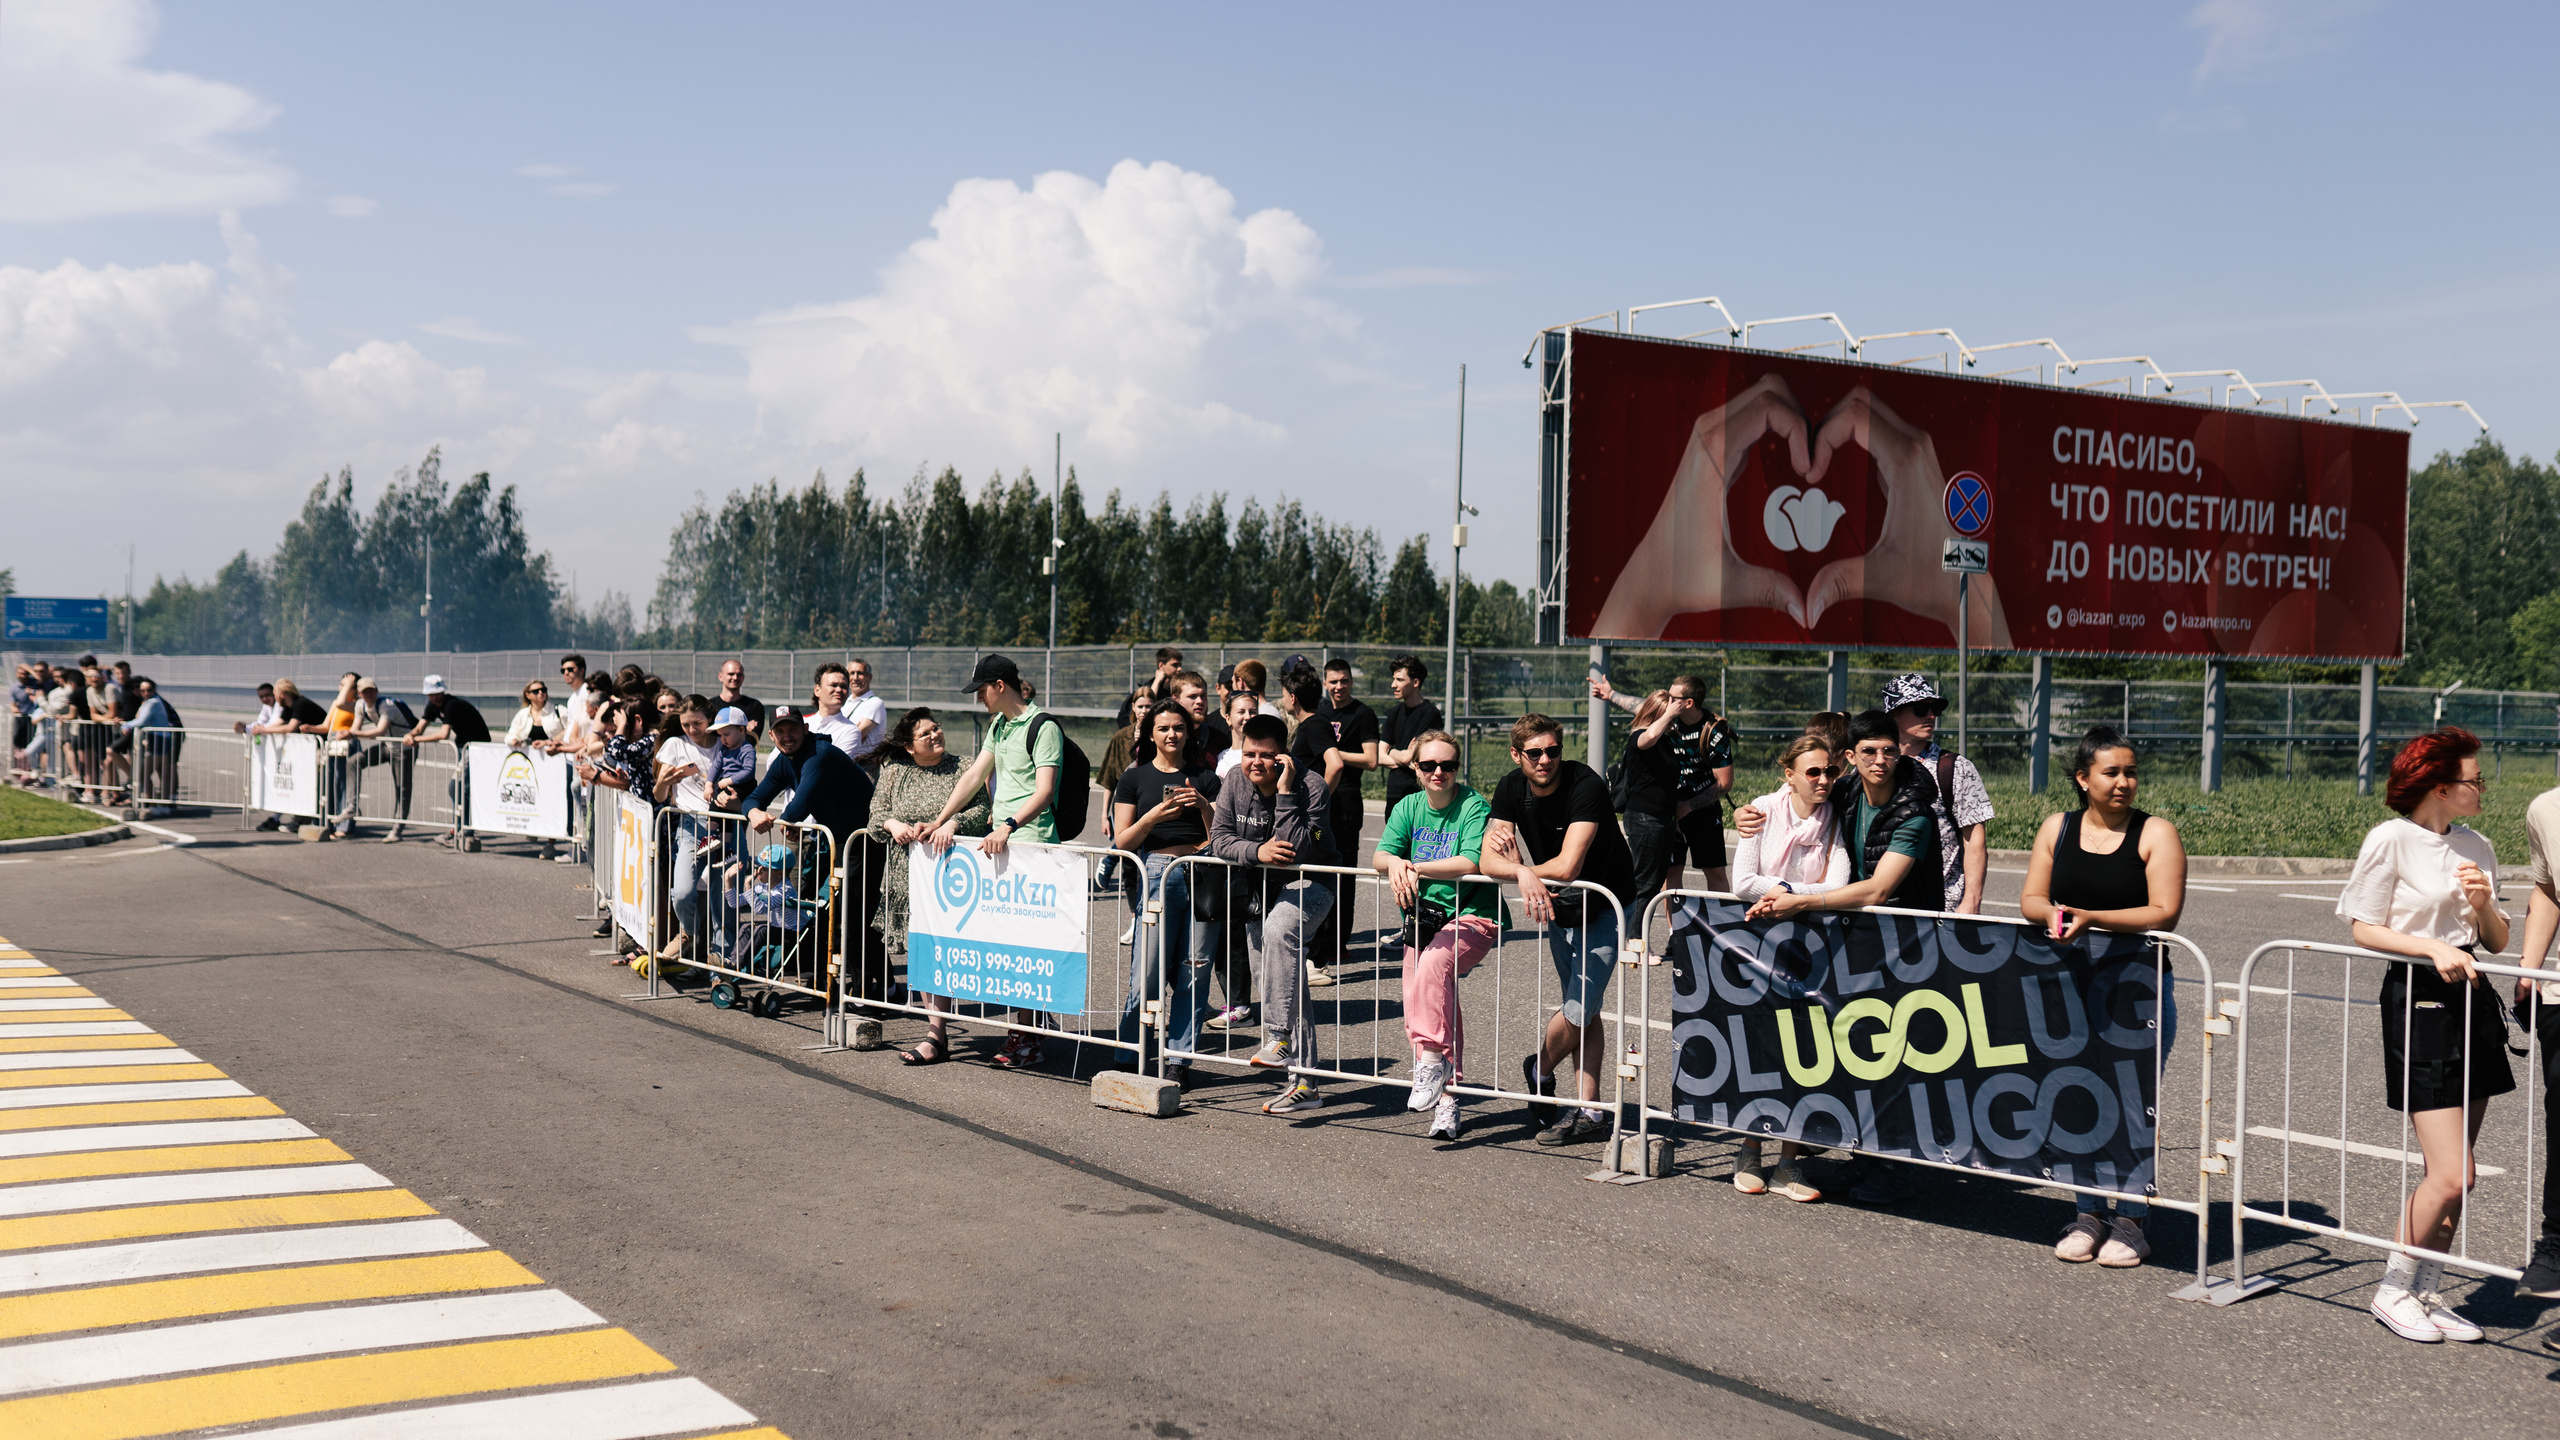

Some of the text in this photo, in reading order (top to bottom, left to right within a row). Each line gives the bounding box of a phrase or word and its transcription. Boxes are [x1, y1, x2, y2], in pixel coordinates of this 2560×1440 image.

[2053, 425, 2202, 483] СПАСИБО,
[2051, 482, 2347, 541] ЧТО ПОСЕТИЛИ НАС!
[2046, 540, 2331, 591] ДО НОВЫХ ВСТРЕЧ!
[2067, 607, 2146, 631] @kazan_expo
[2181, 612, 2252, 633] kazanexpo.ru
[981, 903, 1056, 919] служба эвакуации
[934, 945, 1054, 977] 8 (953) 999-20-90
[934, 969, 1053, 1003] 8 (843) 215-99-11
[1775, 982, 2029, 1088] UGOL
